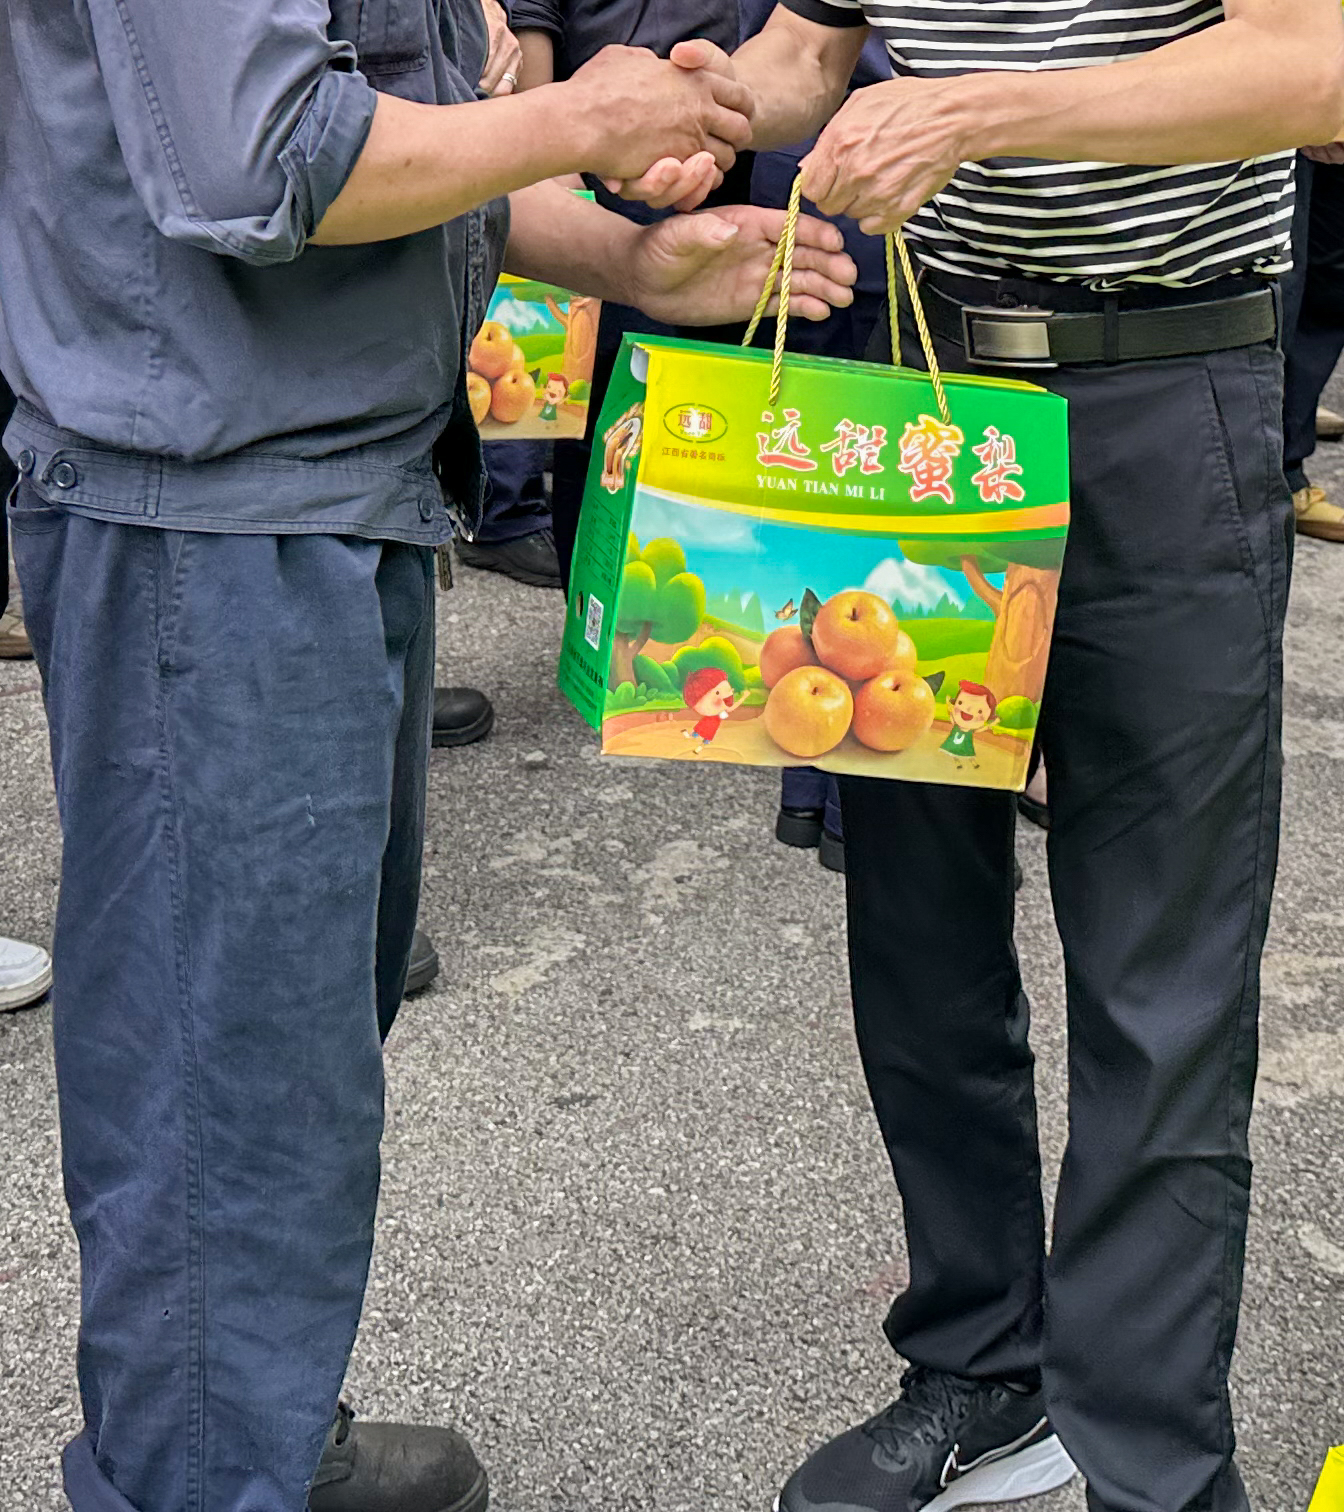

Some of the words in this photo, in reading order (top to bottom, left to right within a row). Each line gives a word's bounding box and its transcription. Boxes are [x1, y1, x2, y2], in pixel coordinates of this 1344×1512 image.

[756, 407, 1025, 504] 远甜蜜梨
[756, 474, 797, 492] YUAN
[803, 479, 839, 496] TIAN
[846, 484, 864, 498] MI
[869, 486, 885, 501] LI
